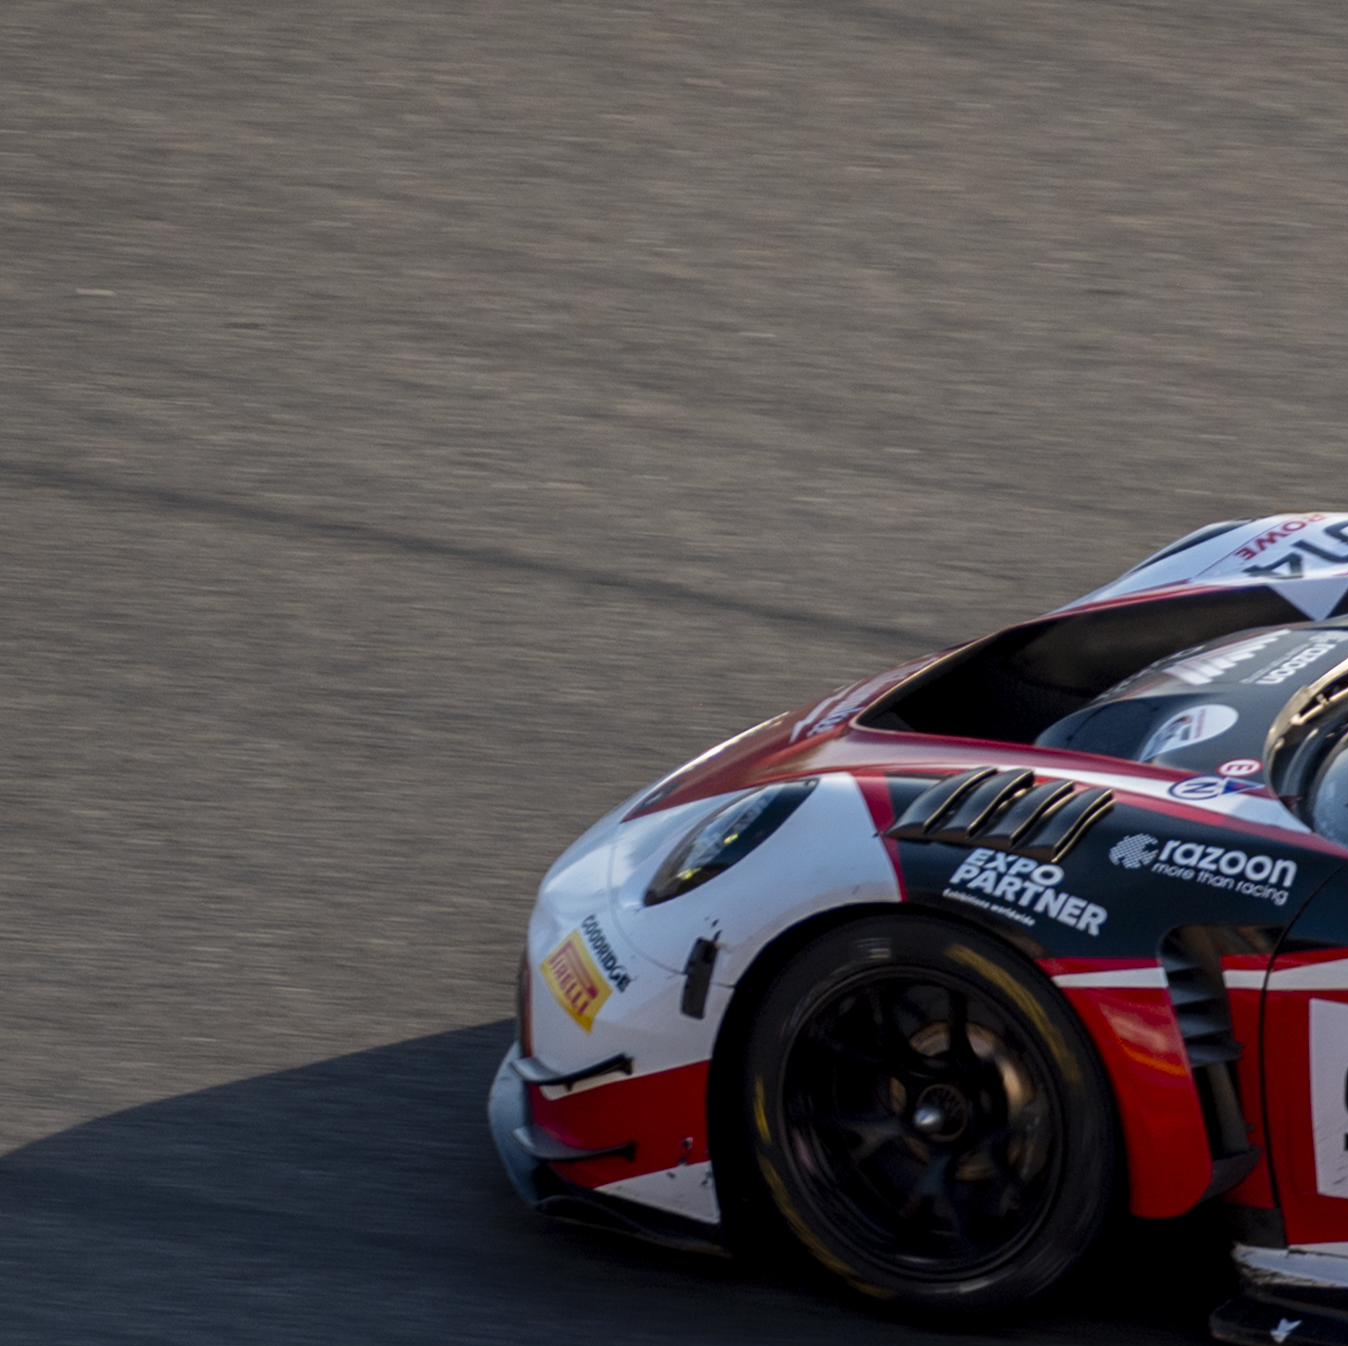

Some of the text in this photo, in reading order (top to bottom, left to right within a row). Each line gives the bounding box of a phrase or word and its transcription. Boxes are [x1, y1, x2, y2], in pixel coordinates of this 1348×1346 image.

[966, 847, 1065, 886] EXPO
[1151, 862, 1290, 907] more than racing
[1159, 839, 1298, 888] razoon
[949, 863, 1108, 937] PARTNER
[547, 939, 599, 1017] PIRELLI
[580, 913, 632, 994] GOODRIDGE
